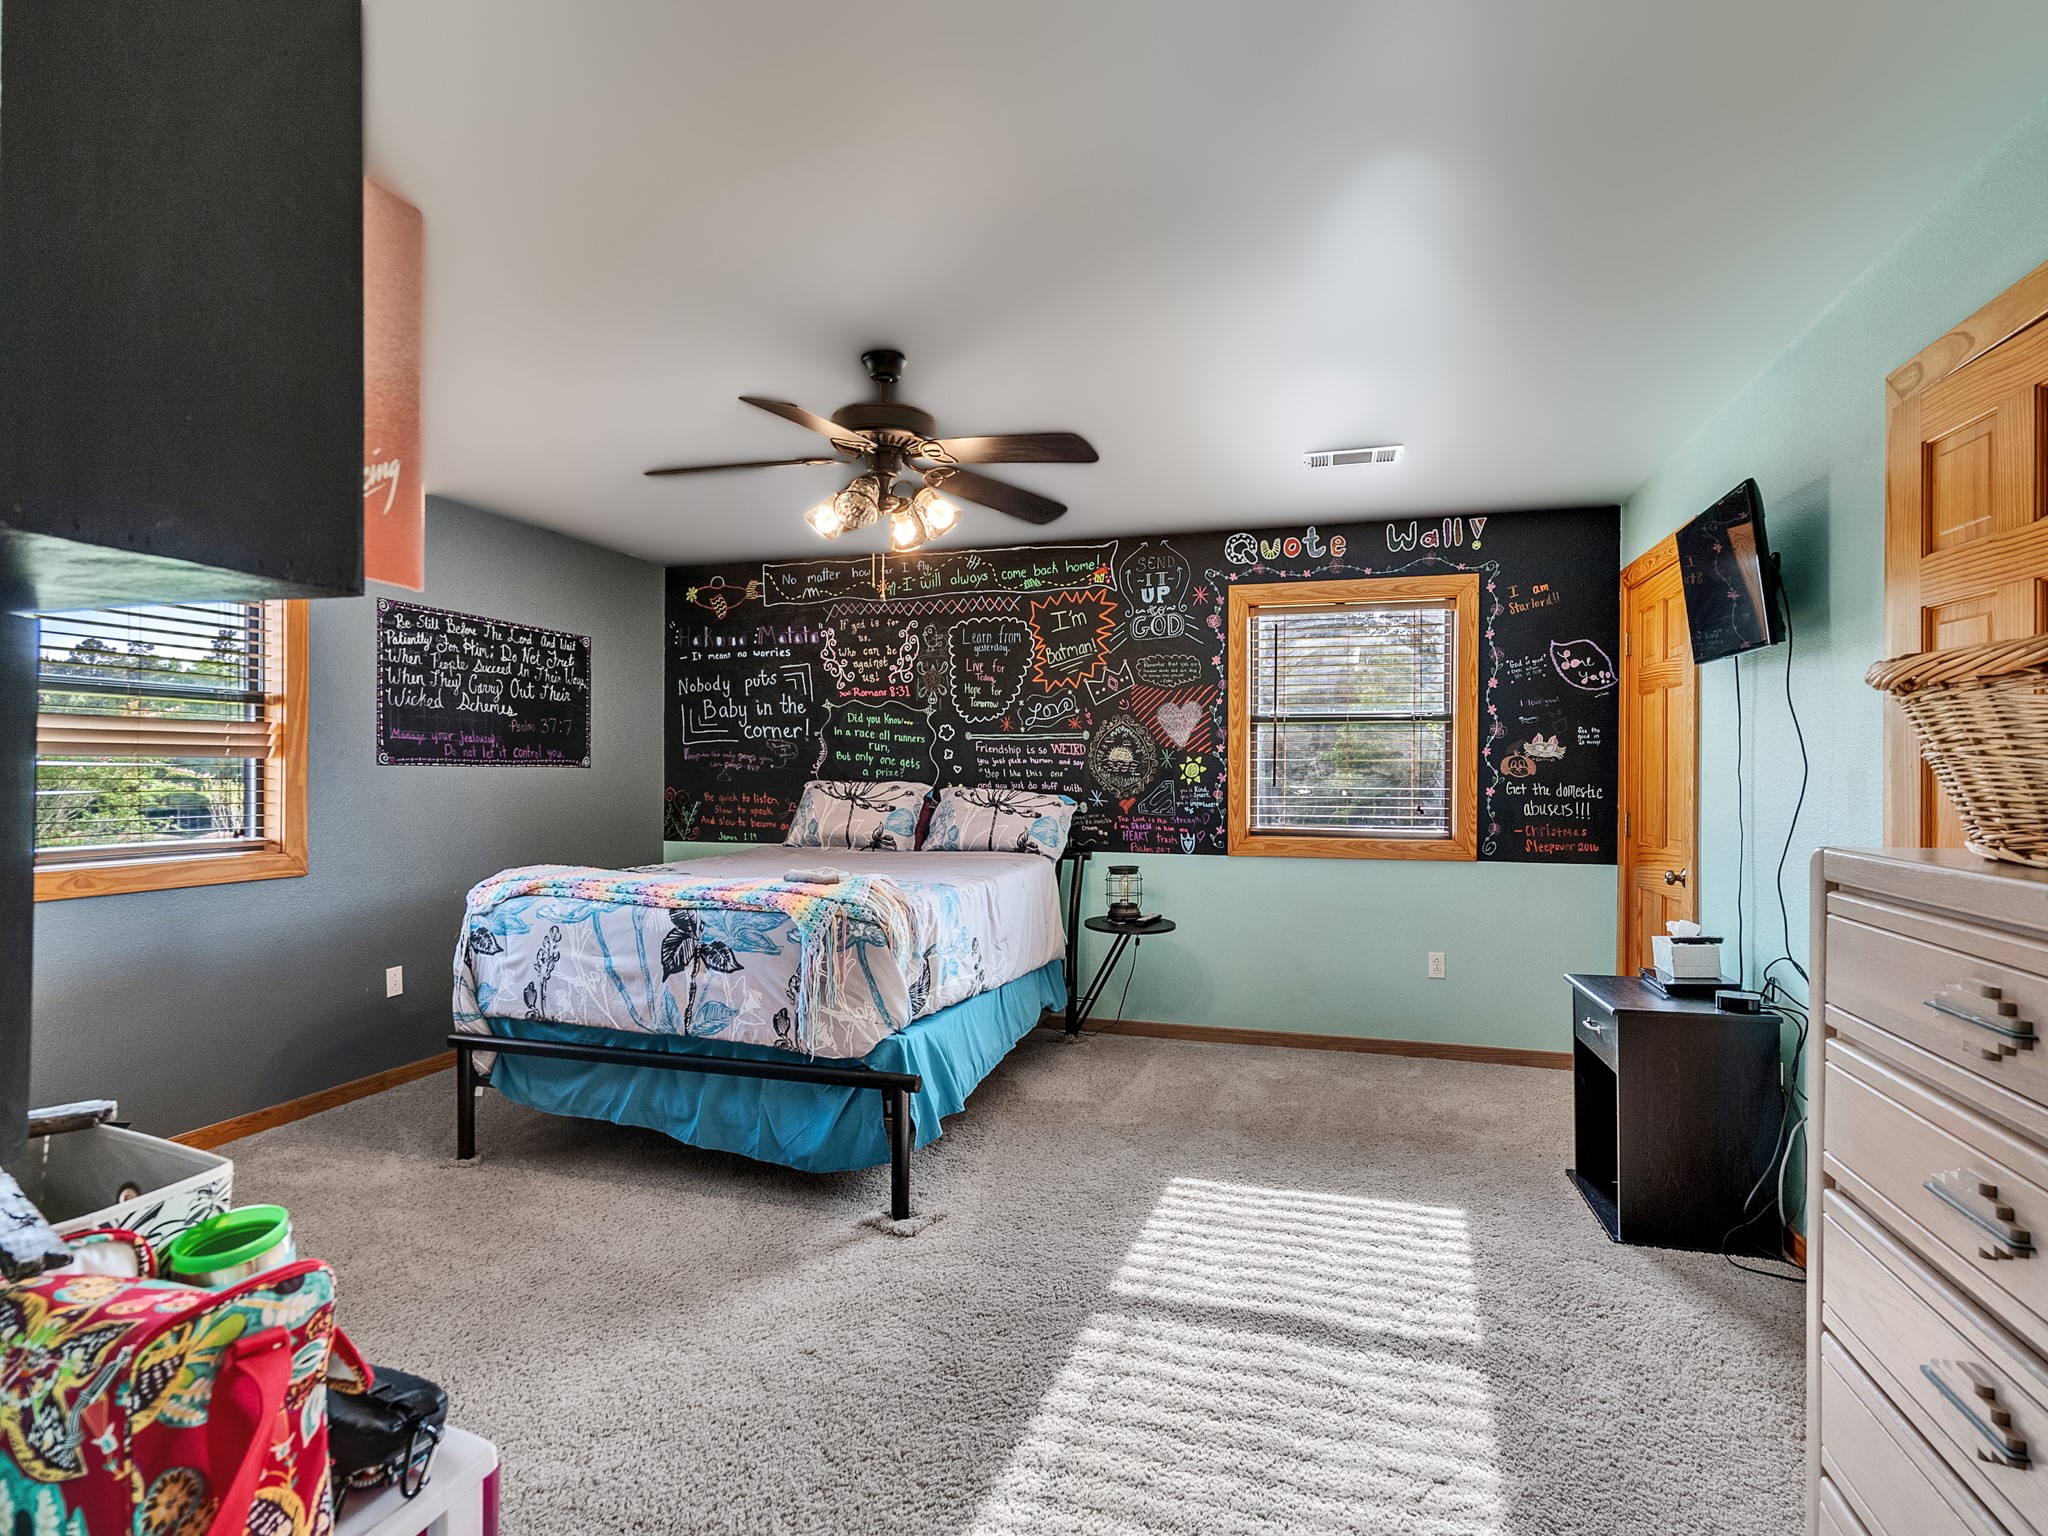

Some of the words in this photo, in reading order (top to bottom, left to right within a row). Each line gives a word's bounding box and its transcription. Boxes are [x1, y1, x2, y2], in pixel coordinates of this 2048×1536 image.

[1224, 526, 1347, 564] Quote
[1386, 517, 1488, 552] Wall!
[903, 578, 913, 592] I
[920, 572, 942, 590] will
[950, 569, 989, 589] always
[1001, 568, 1027, 580] come
[1033, 558, 1059, 577] back
[1065, 553, 1101, 573] home!
[1136, 556, 1176, 572] SEND
[782, 574, 797, 584] No
[807, 568, 841, 584] matter
[851, 567, 871, 578] how
[902, 562, 911, 573] I
[1145, 572, 1169, 586] IT
[1141, 585, 1170, 604] UP
[1508, 585, 1519, 598] I
[1532, 583, 1549, 595] am
[1508, 592, 1560, 615] Starlord!!
[840, 619, 850, 630] If
[870, 618, 880, 628] is
[886, 618, 900, 626] for
[1050, 610, 1087, 632] I'm
[1132, 613, 1183, 638] GOD
[394, 613, 412, 629] Be
[416, 615, 440, 630] Still
[445, 618, 477, 638] Before
[483, 624, 503, 640] The
[507, 628, 532, 645] Lord
[540, 635, 556, 648] And
[560, 638, 576, 651] Wait
[962, 628, 992, 644] Learn
[998, 624, 1022, 644] from
[384, 629, 432, 652] Patiently
[436, 634, 460, 653] For
[462, 637, 494, 658] Him;
[500, 644, 518, 662] Do
[522, 646, 541, 666] Not
[546, 650, 575, 669] Fret
[692, 650, 703, 662] It
[708, 652, 731, 660] means
[737, 650, 748, 658] no
[753, 647, 792, 658] worries
[838, 647, 857, 657] Who
[863, 648, 880, 656] can
[886, 644, 898, 655] be
[1045, 638, 1098, 664] Batman!
[384, 648, 423, 665] When
[430, 652, 468, 677] People
[472, 659, 512, 675] Succeed
[517, 663, 530, 677] In
[534, 666, 562, 683] Their
[852, 656, 888, 674] against
[966, 658, 984, 673] Live
[992, 658, 1006, 673] for
[1510, 658, 1523, 668] God
[384, 666, 426, 686] When
[430, 669, 462, 696] They
[468, 674, 504, 703] Carry
[510, 678, 535, 700] Out
[540, 683, 572, 701] Their
[678, 674, 730, 698] Nobody
[744, 669, 778, 696] puts
[862, 671, 880, 683] us!
[385, 687, 444, 709] Wicked
[852, 686, 888, 696] Romans
[889, 684, 911, 698] 8:31
[964, 682, 982, 698] Hope
[703, 698, 748, 728] Baby
[756, 699, 773, 716] in
[779, 693, 807, 714] the
[970, 696, 999, 708] Tomorrow
[847, 712, 864, 723] Did
[866, 716, 881, 728] you
[1025, 697, 1074, 726] Love
[540, 718, 573, 736] 37:7
[744, 718, 810, 742] corner!
[834, 726, 843, 736] In
[854, 729, 876, 739] race
[879, 730, 890, 741] all
[894, 734, 926, 744] runners
[390, 728, 426, 745] Manage
[432, 732, 454, 744] your
[444, 744, 457, 756] Do
[463, 745, 476, 758] not
[482, 745, 494, 758] let
[498, 745, 507, 758] it
[513, 744, 542, 759] control
[868, 742, 890, 754] run,
[975, 740, 1022, 758] Friendship
[1026, 744, 1036, 754] is
[1038, 746, 1048, 754] so
[1050, 743, 1087, 756] WEIRD
[836, 750, 852, 761] But
[855, 752, 874, 766] only
[880, 756, 896, 766] one
[900, 758, 920, 770] gets
[976, 758, 990, 766] you
[992, 757, 1006, 766] just
[1008, 757, 1022, 766] pick
[1072, 760, 1085, 770] say
[862, 768, 869, 776] a
[875, 768, 904, 778] prize?
[1009, 768, 1022, 777] like
[1026, 769, 1043, 778] this
[978, 780, 992, 788] and
[1010, 781, 1025, 790] just
[1027, 781, 1038, 790] do
[1042, 782, 1058, 790] stuff
[1064, 783, 1082, 792] with
[1506, 781, 1528, 796] Get
[1532, 782, 1551, 796] the
[1556, 782, 1604, 800] domestic
[704, 792, 715, 802] Be
[718, 792, 738, 804] quick
[742, 793, 751, 803] to
[714, 804, 732, 814] Slow
[737, 804, 746, 814] to
[1523, 800, 1591, 820] abusers!!!
[700, 816, 716, 825] And
[738, 817, 747, 827] to
[750, 818, 777, 828] become
[718, 832, 738, 841] James
[743, 832, 758, 841] 1:19
[1122, 830, 1150, 842] HEART
[1156, 832, 1178, 845] trusts
[1525, 838, 1576, 854] Sleepover
[1577, 842, 1600, 852] 2016
